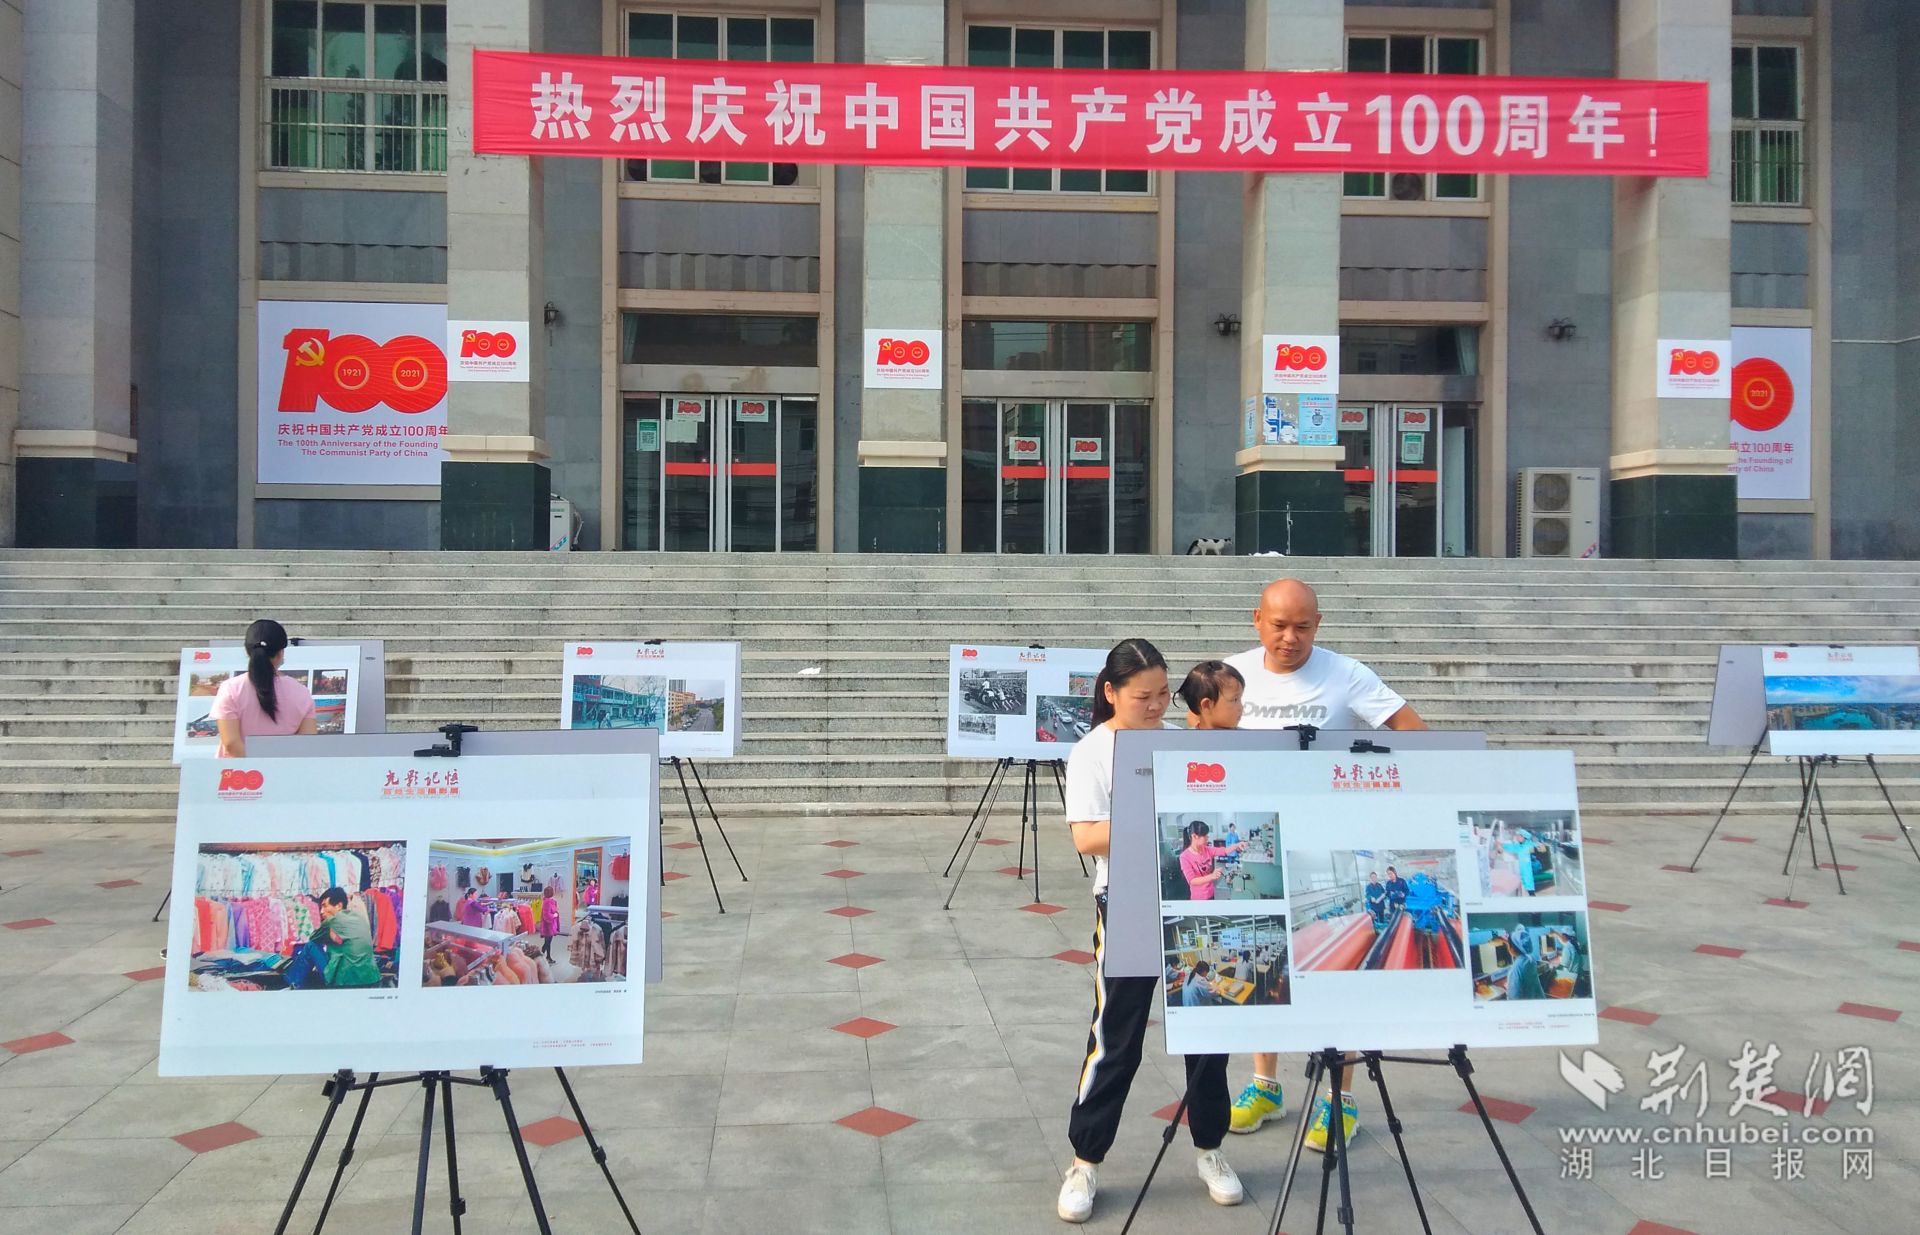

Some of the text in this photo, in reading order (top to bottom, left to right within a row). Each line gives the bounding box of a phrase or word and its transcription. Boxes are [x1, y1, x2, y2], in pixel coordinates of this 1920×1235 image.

[343, 368, 361, 377] 1921
[400, 369, 420, 378] 2021
[278, 423, 448, 437] 庆祝中国共产党成立100周年
[278, 439, 439, 449] The 100th Anniversary of the Founding
[319, 449, 367, 457] Communist
[369, 450, 391, 458] Party
